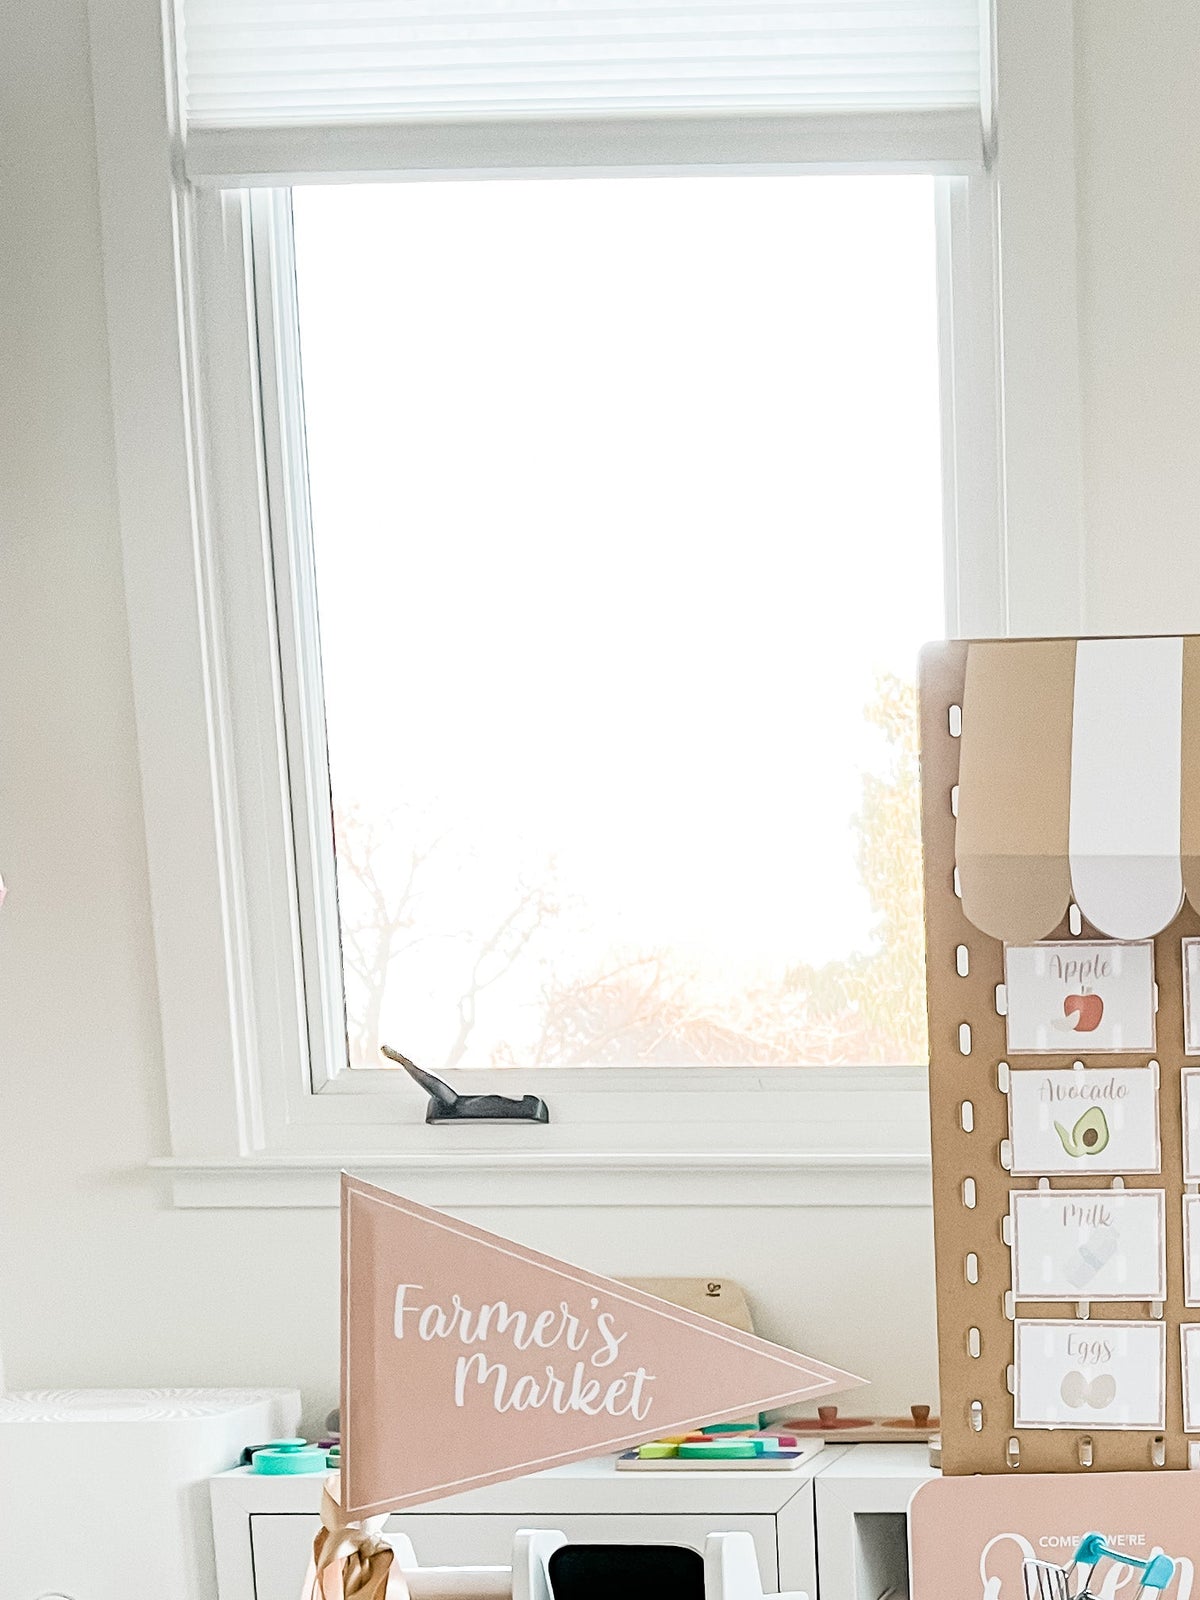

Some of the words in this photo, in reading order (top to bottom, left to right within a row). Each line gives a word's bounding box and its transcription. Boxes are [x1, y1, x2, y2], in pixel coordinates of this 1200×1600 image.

[1049, 954, 1112, 984] Apple
[1040, 1078, 1129, 1102] Avocado
[1061, 1204, 1114, 1229] Milk
[393, 1283, 628, 1367] Farmer's
[1066, 1333, 1114, 1365] Eggs
[454, 1352, 657, 1421] Market
[1038, 1535, 1080, 1548] COME
